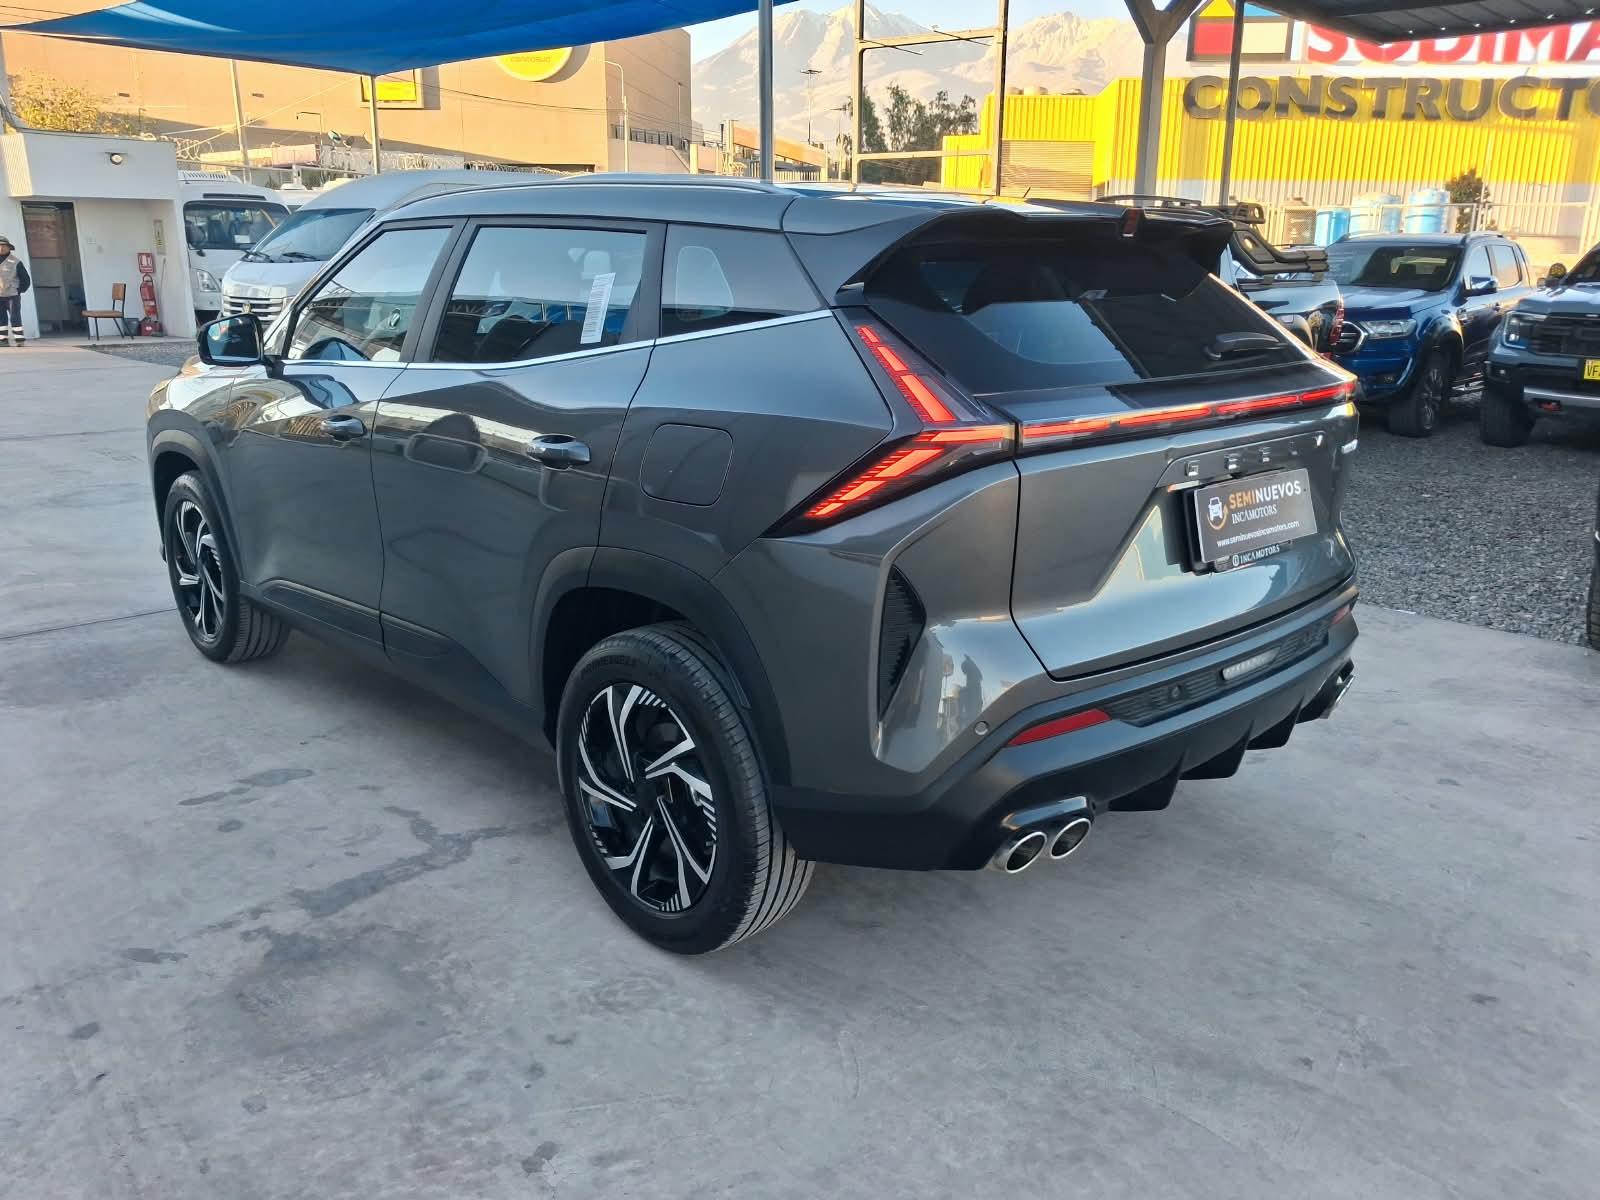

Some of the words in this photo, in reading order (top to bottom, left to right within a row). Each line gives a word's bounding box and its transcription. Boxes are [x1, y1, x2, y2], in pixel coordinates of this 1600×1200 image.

[1183, 75, 1600, 120] CONSTRUCT
[1229, 480, 1302, 509] SEMINUEVOS
[1231, 503, 1278, 524] INCAMOTORS
